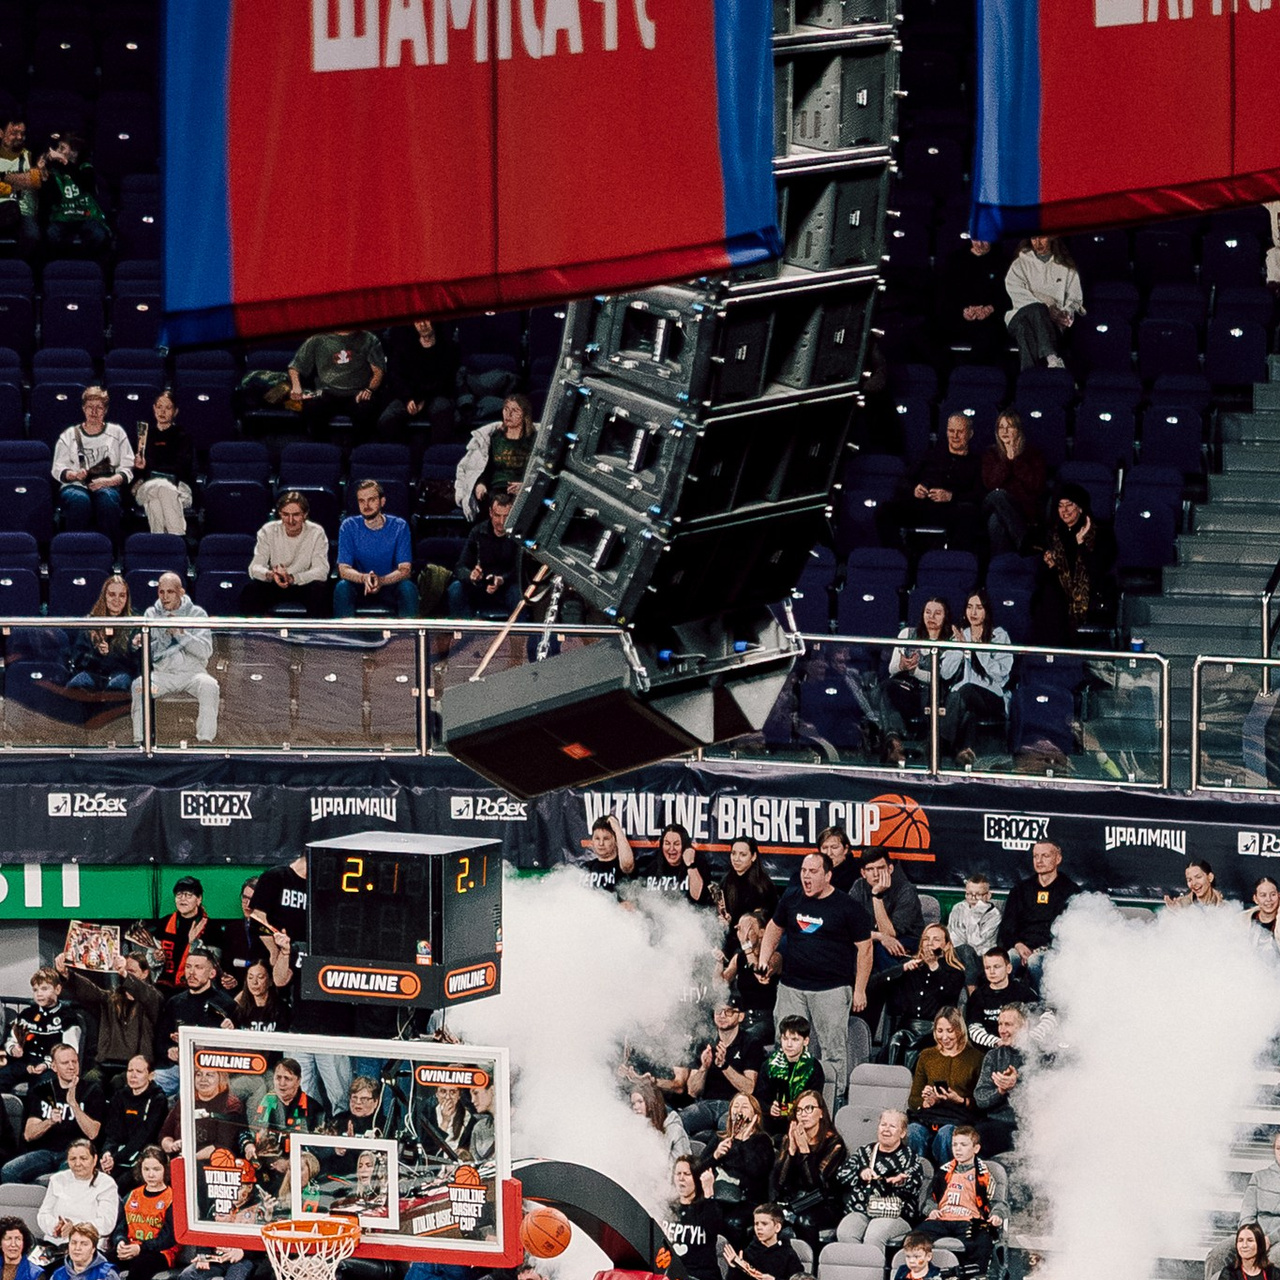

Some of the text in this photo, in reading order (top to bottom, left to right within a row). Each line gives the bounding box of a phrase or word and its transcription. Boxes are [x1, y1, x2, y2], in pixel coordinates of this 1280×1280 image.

[73, 793, 127, 812] Робек
[184, 793, 249, 817] BROZEX
[311, 797, 396, 822] УРАЛМАШ
[476, 796, 527, 817] Робек
[583, 792, 881, 846] WINLINE BASKET CUP
[986, 816, 1048, 840] BROZEX
[1105, 826, 1186, 856] УРАЛМАШ
[326, 971, 398, 992] WINLINE
[449, 969, 486, 992] WINLINE
[200, 1054, 250, 1070] WINLINE
[420, 1069, 472, 1084] WINLINE
[204, 1171, 241, 1186] WINLINE
[207, 1185, 239, 1200] BASKET
[449, 1187, 486, 1203] WINLINE
[215, 1200, 232, 1214] CUP
[452, 1202, 482, 1218] BASKET
[459, 1217, 476, 1231] CUP
